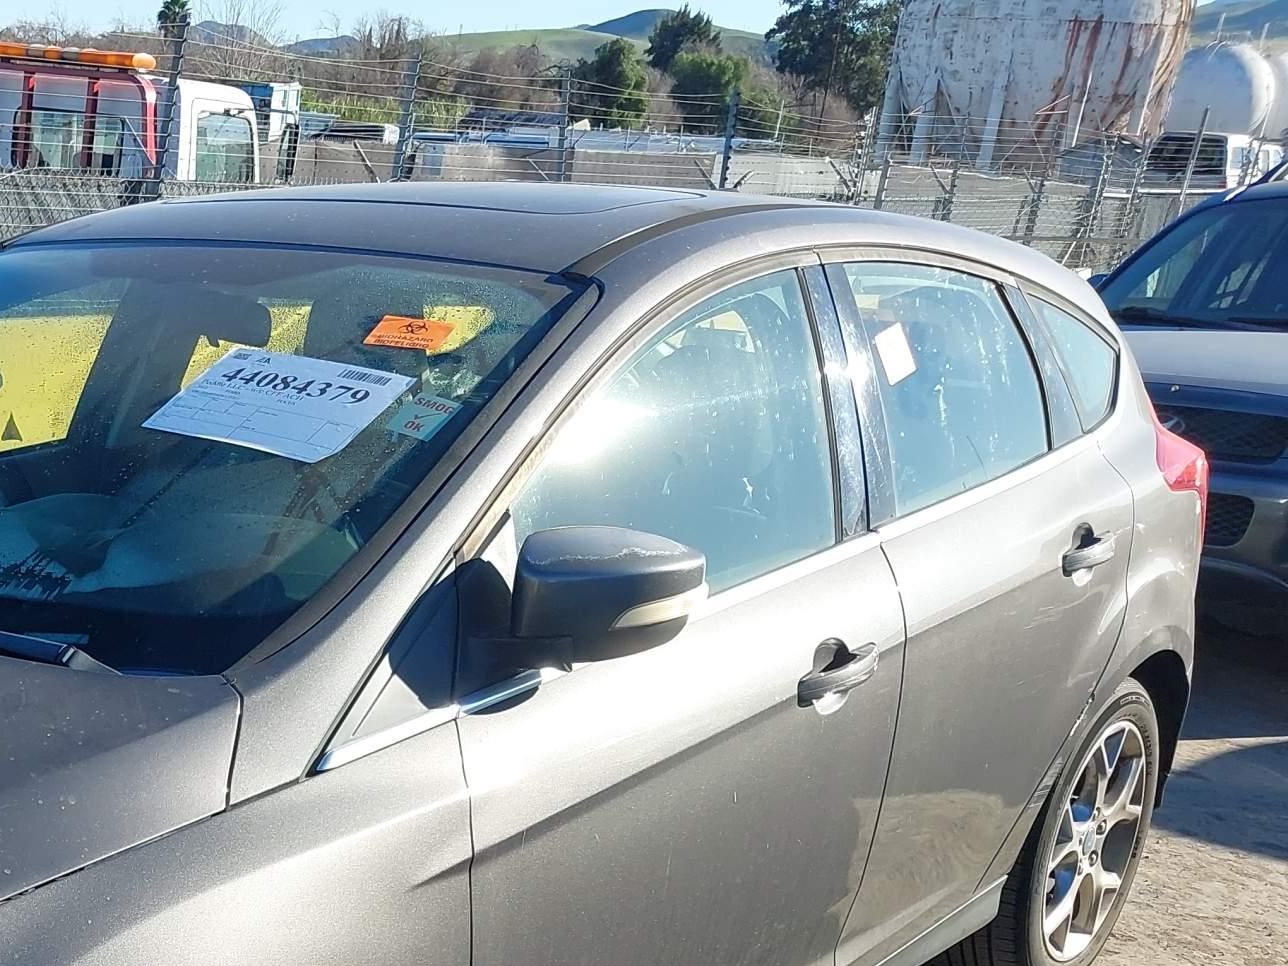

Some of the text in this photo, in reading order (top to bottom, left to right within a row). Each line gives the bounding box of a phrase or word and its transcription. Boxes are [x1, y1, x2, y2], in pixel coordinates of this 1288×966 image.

[221, 367, 371, 406] 44084379
[414, 397, 455, 415] SMOG
[403, 421, 425, 432] OK
